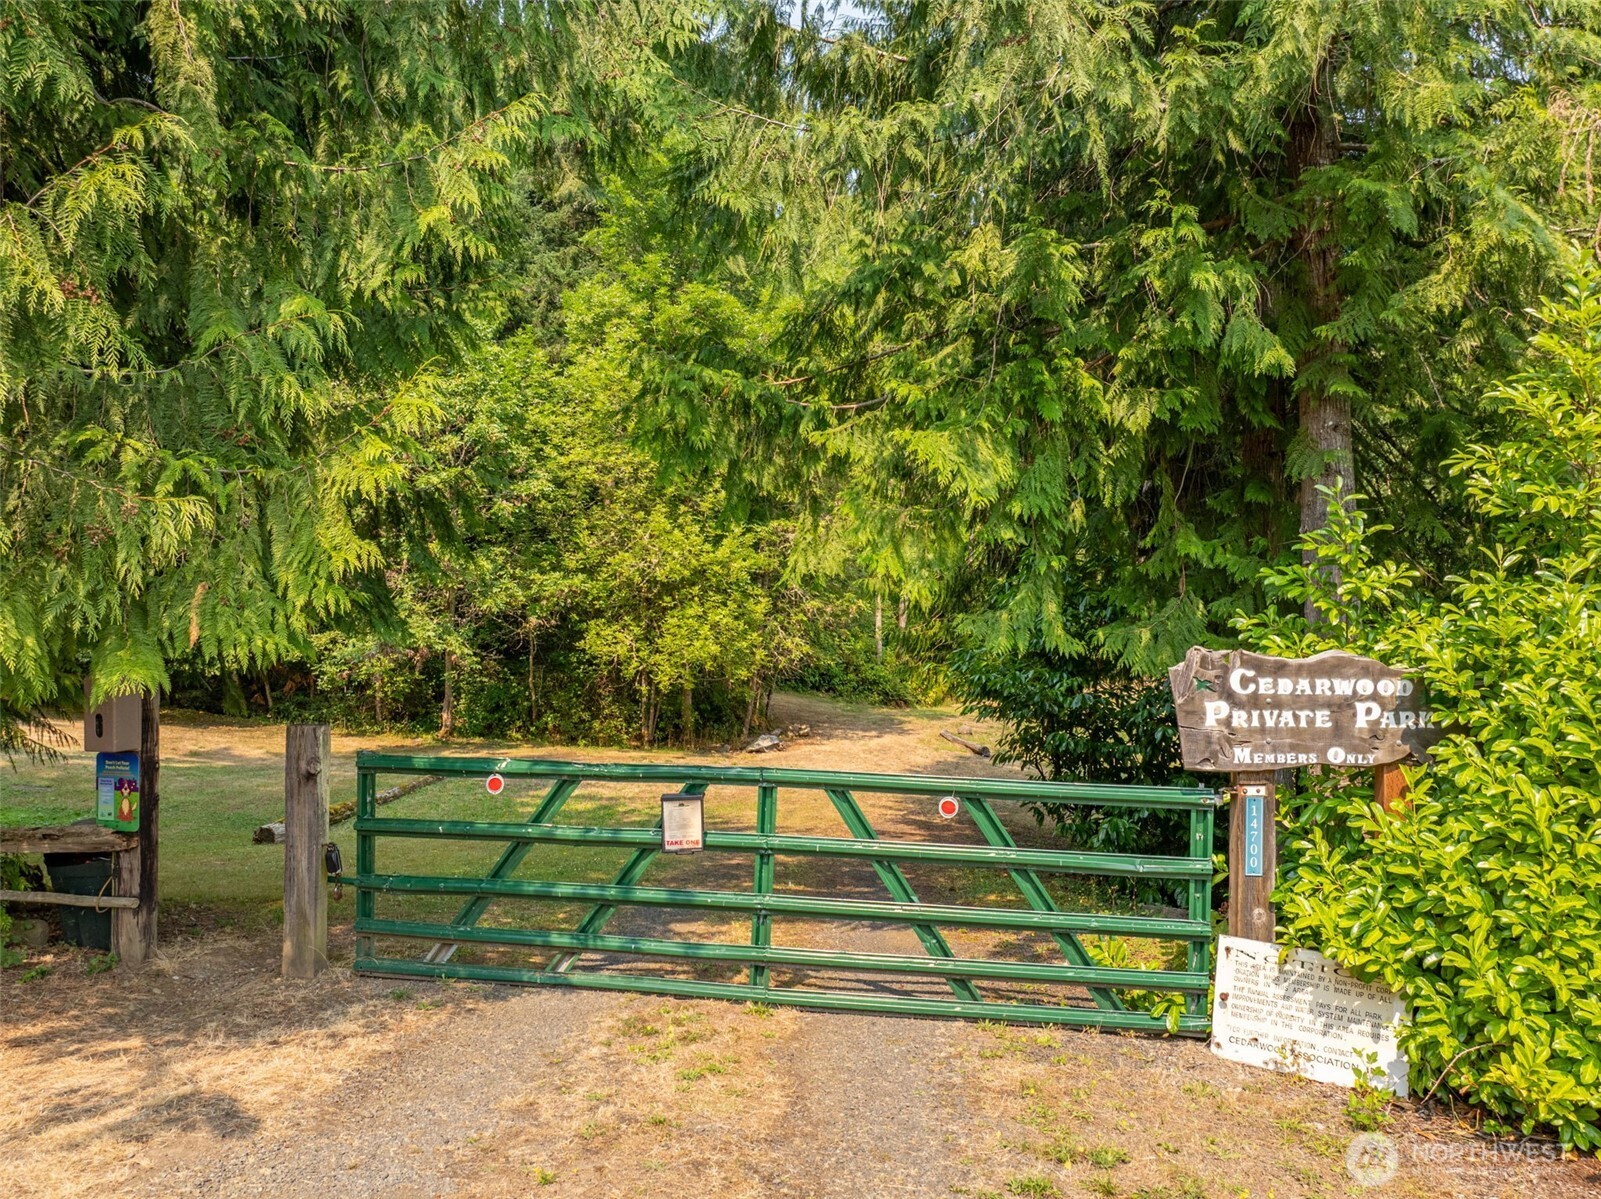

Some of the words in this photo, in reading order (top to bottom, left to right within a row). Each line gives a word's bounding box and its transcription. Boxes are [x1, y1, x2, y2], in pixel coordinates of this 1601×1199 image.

[1229, 667, 1413, 697] CEDARWOOD
[1203, 700, 1333, 729] PRIVATE
[1354, 701, 1435, 730] PARK
[1233, 747, 1318, 765] MEMBERS
[1327, 747, 1376, 765] ONLY
[1249, 805, 1258, 868] 14700
[1233, 976, 1259, 986] OWNERS
[1235, 960, 1248, 968] THIS
[1278, 968, 1315, 980] MAINTAINED
[1318, 975, 1326, 983] BY
[1334, 978, 1372, 991] NON-PROFIT
[1334, 986, 1351, 996] MADE
[1379, 995, 1392, 1004] ALL
[1231, 993, 1278, 1008] IMPROVEMENTS
[1281, 1003, 1293, 1011] AND
[1317, 1010, 1343, 1021] SYSTEM
[1316, 1001, 1331, 1010] PAYS
[1335, 1005, 1348, 1014] FOR
[1350, 1009, 1362, 1017] ALL
[1365, 1011, 1383, 1021] PARK
[1231, 1003, 1264, 1014] OWNERSHIP
[1275, 1011, 1304, 1023] PROPERTY
[1320, 1021, 1335, 1030] THIS
[1338, 1025, 1354, 1034] AREA
[1358, 1030, 1389, 1042] REQUIRES
[1282, 1021, 1293, 1030] THE
[1298, 1025, 1347, 1042] CORPORATION.
[1228, 1035, 1287, 1053] CEDARWOOD
[1323, 1046, 1353, 1058] CONTACT
